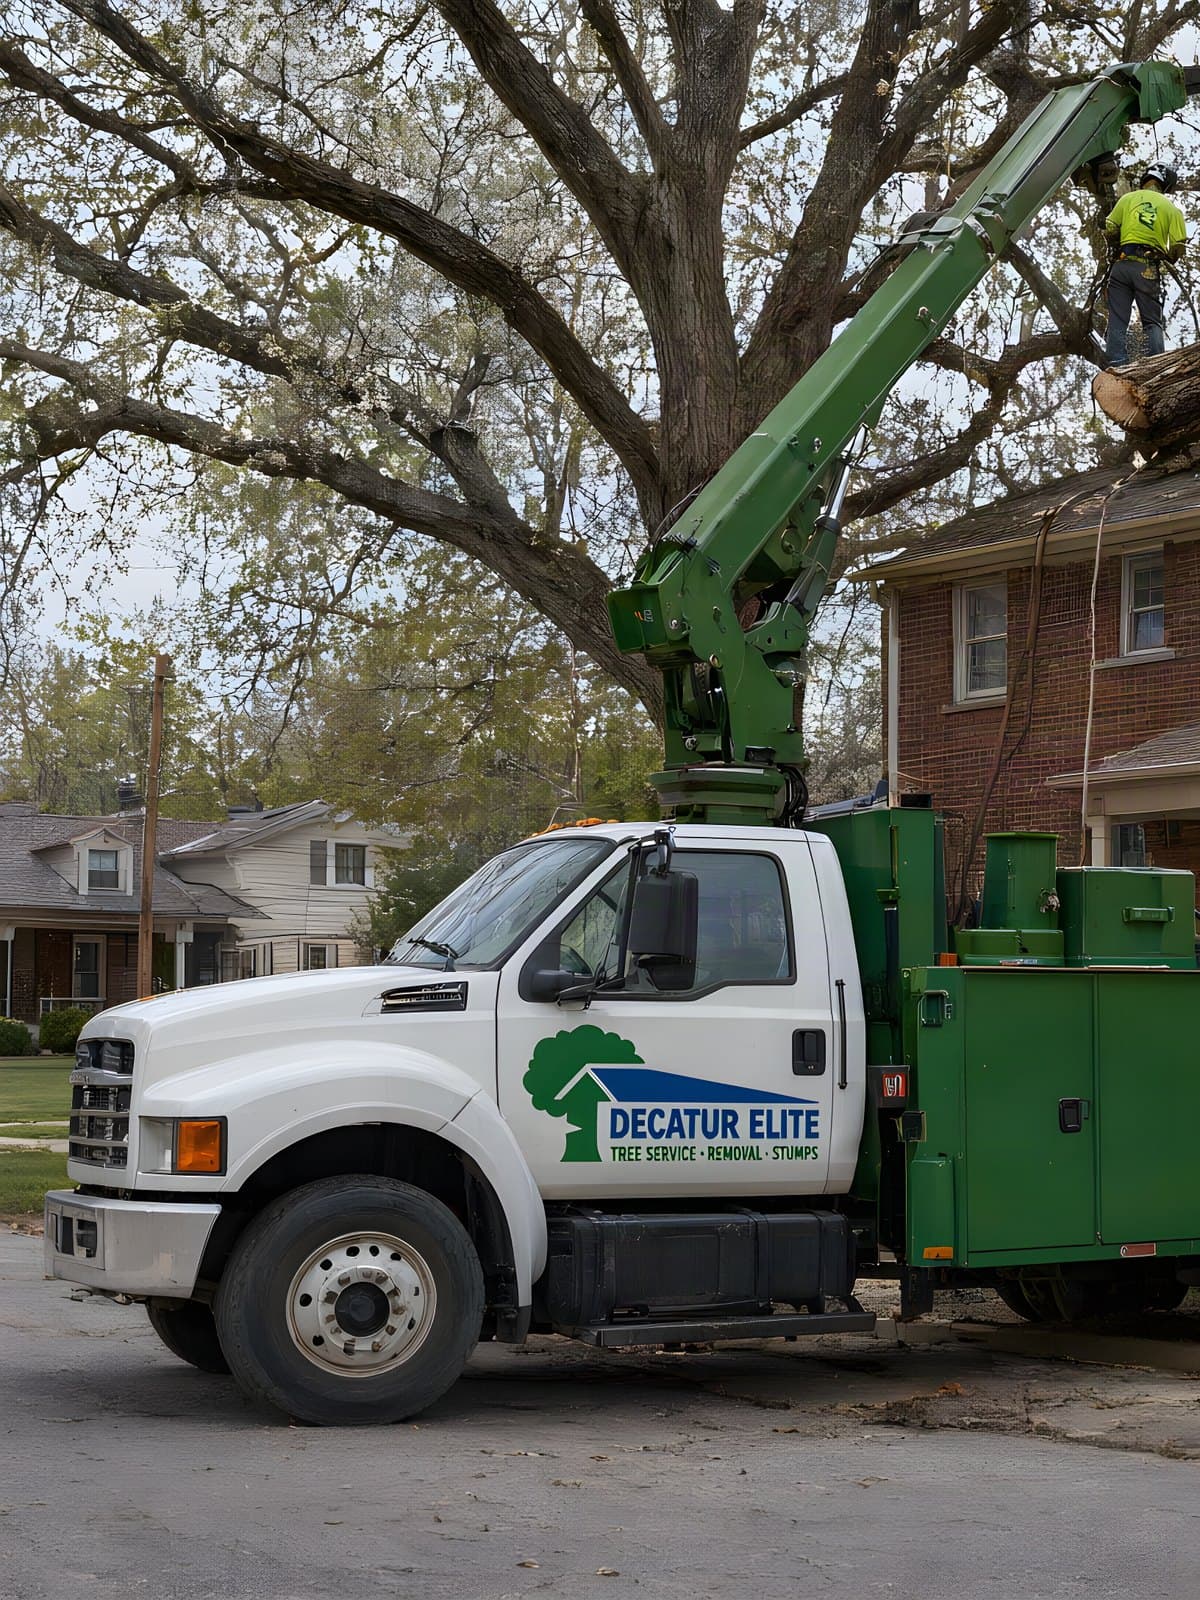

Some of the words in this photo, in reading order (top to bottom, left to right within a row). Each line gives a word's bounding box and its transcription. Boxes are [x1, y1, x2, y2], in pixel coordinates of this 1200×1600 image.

[610, 1107, 740, 1140] DECATUR
[749, 1108, 820, 1139] ELITE
[611, 1145, 642, 1162] TREE
[646, 1145, 697, 1161] SERVICE
[707, 1145, 763, 1161] REMOVAL
[772, 1145, 819, 1161] STUMPS
